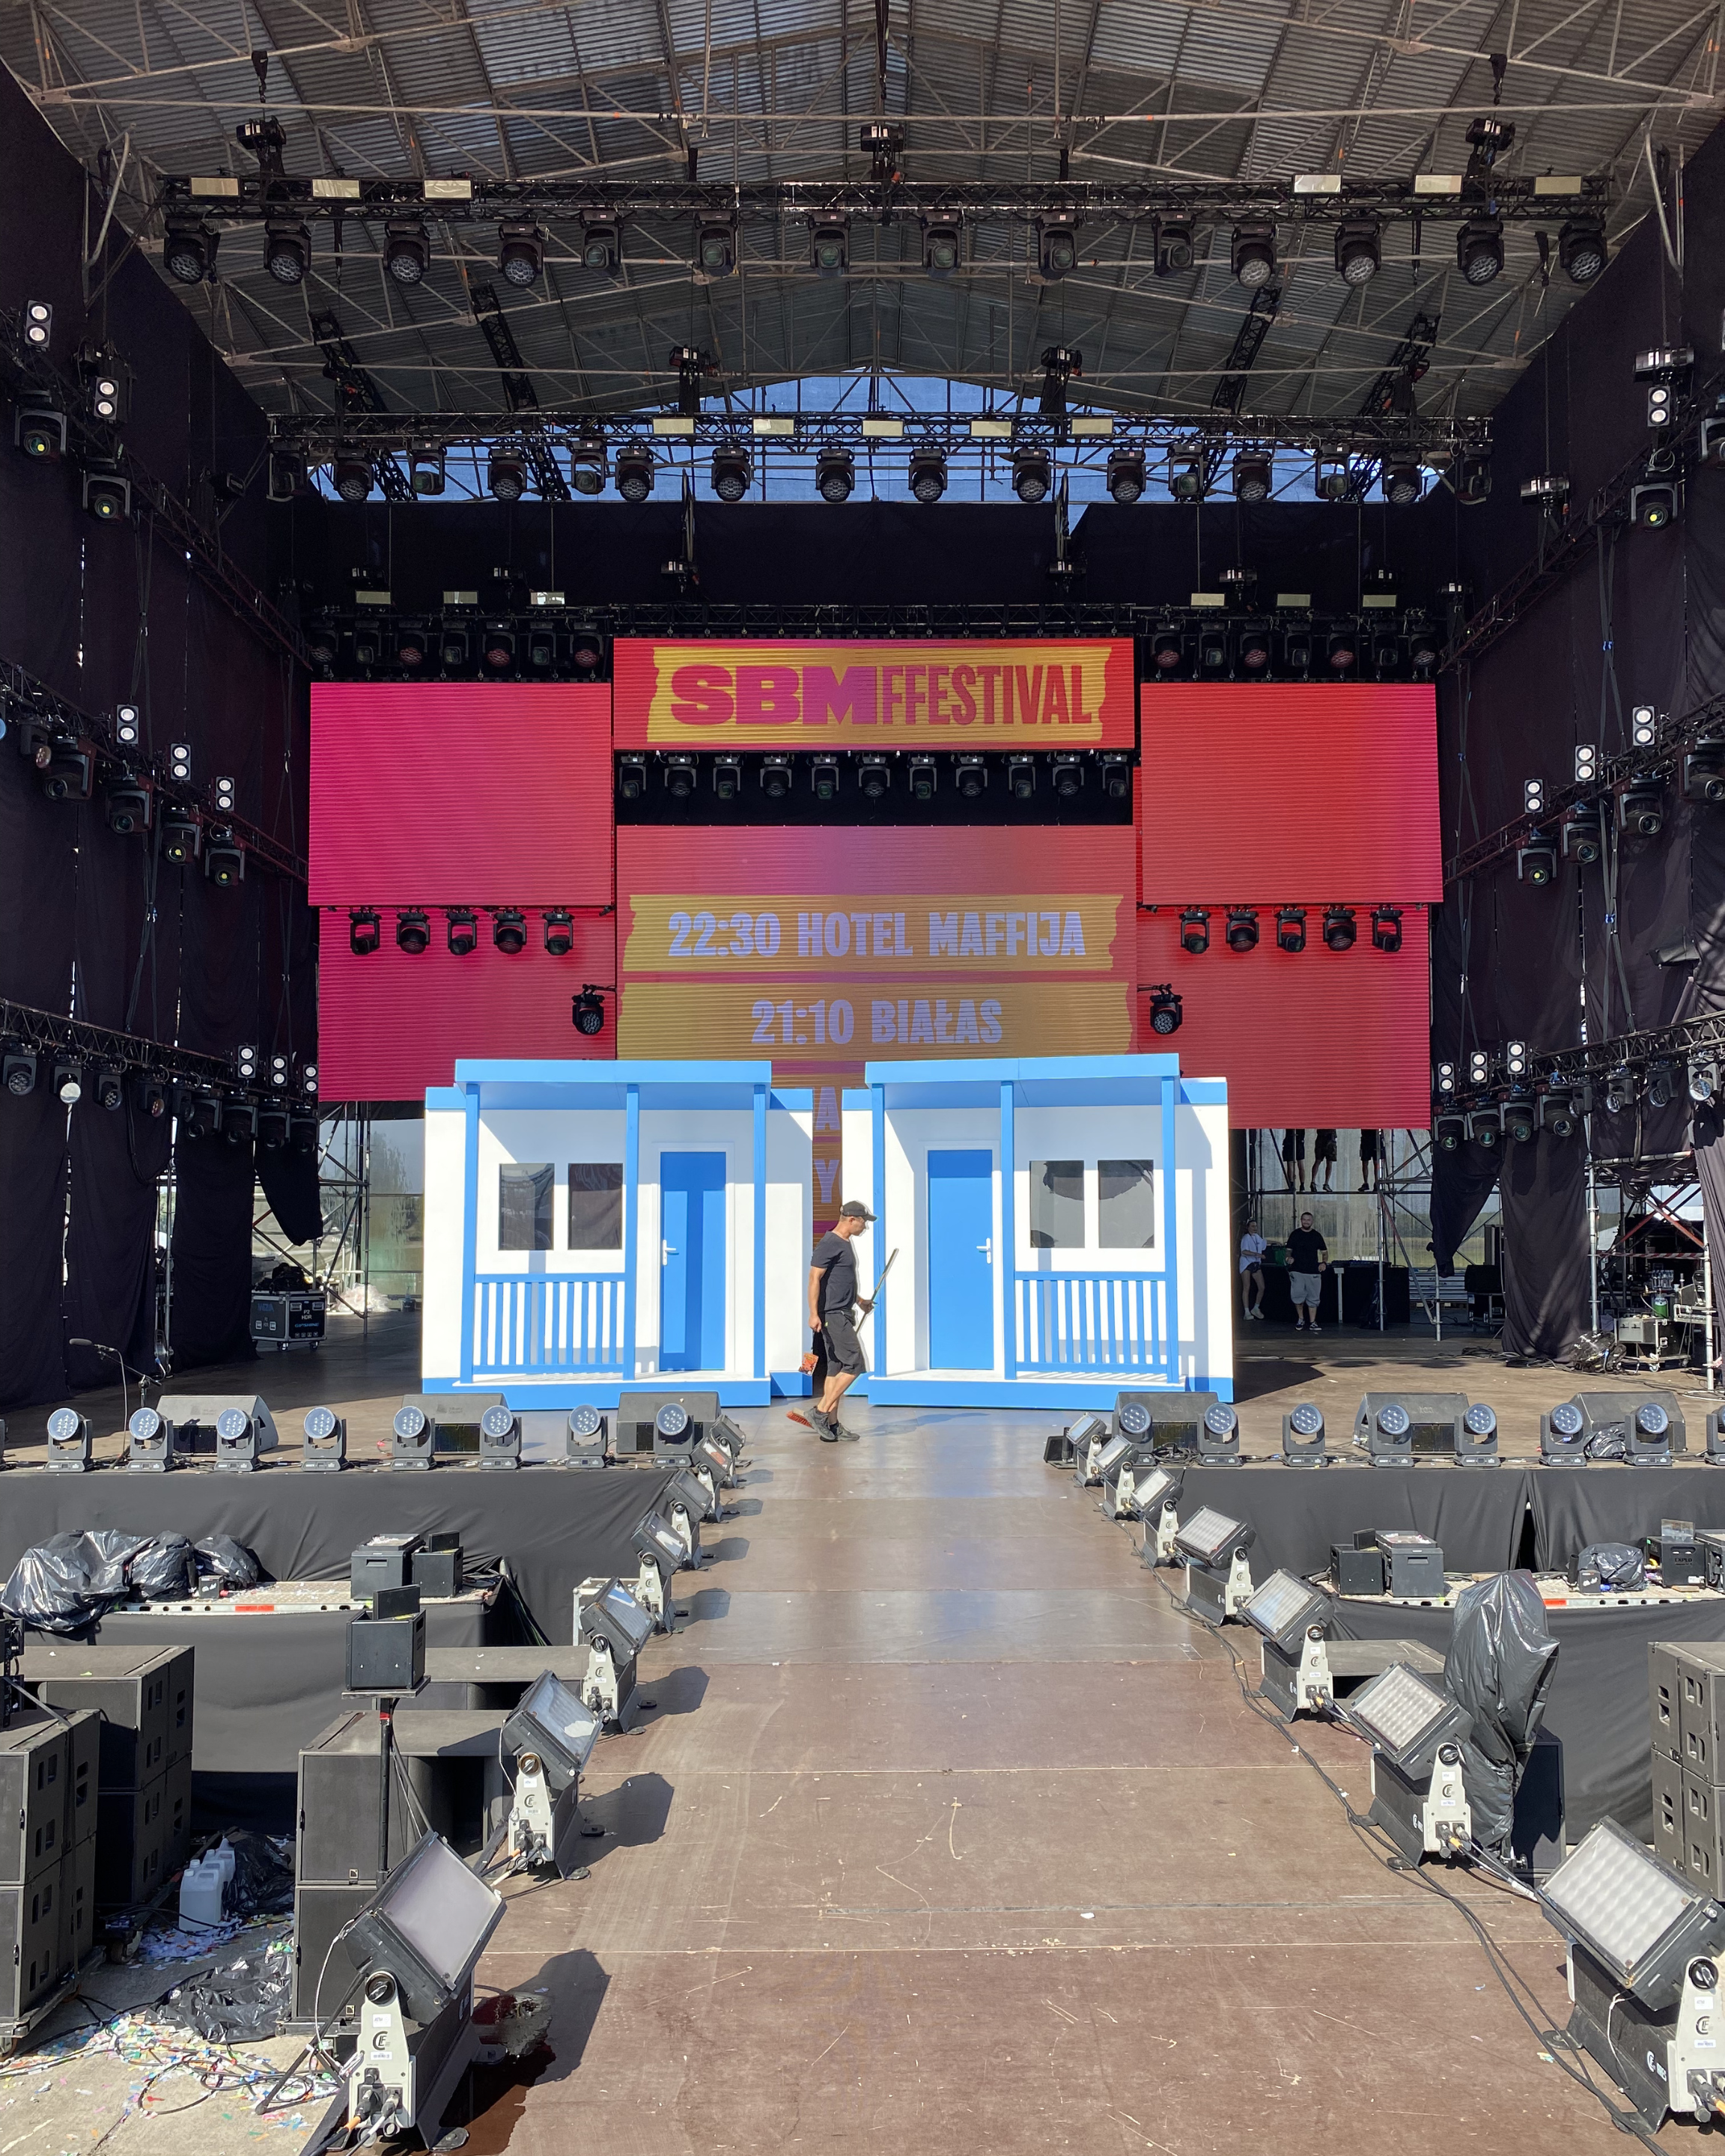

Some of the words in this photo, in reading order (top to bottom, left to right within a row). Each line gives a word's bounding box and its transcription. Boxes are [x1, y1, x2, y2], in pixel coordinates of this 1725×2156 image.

[671, 665, 877, 725] SBM
[669, 912, 781, 957] 22:30
[798, 913, 913, 957] HOTEL
[928, 912, 1086, 957] MAFFIJA
[751, 999, 855, 1045] 21:10
[871, 999, 1003, 1044] BIAŁAS
